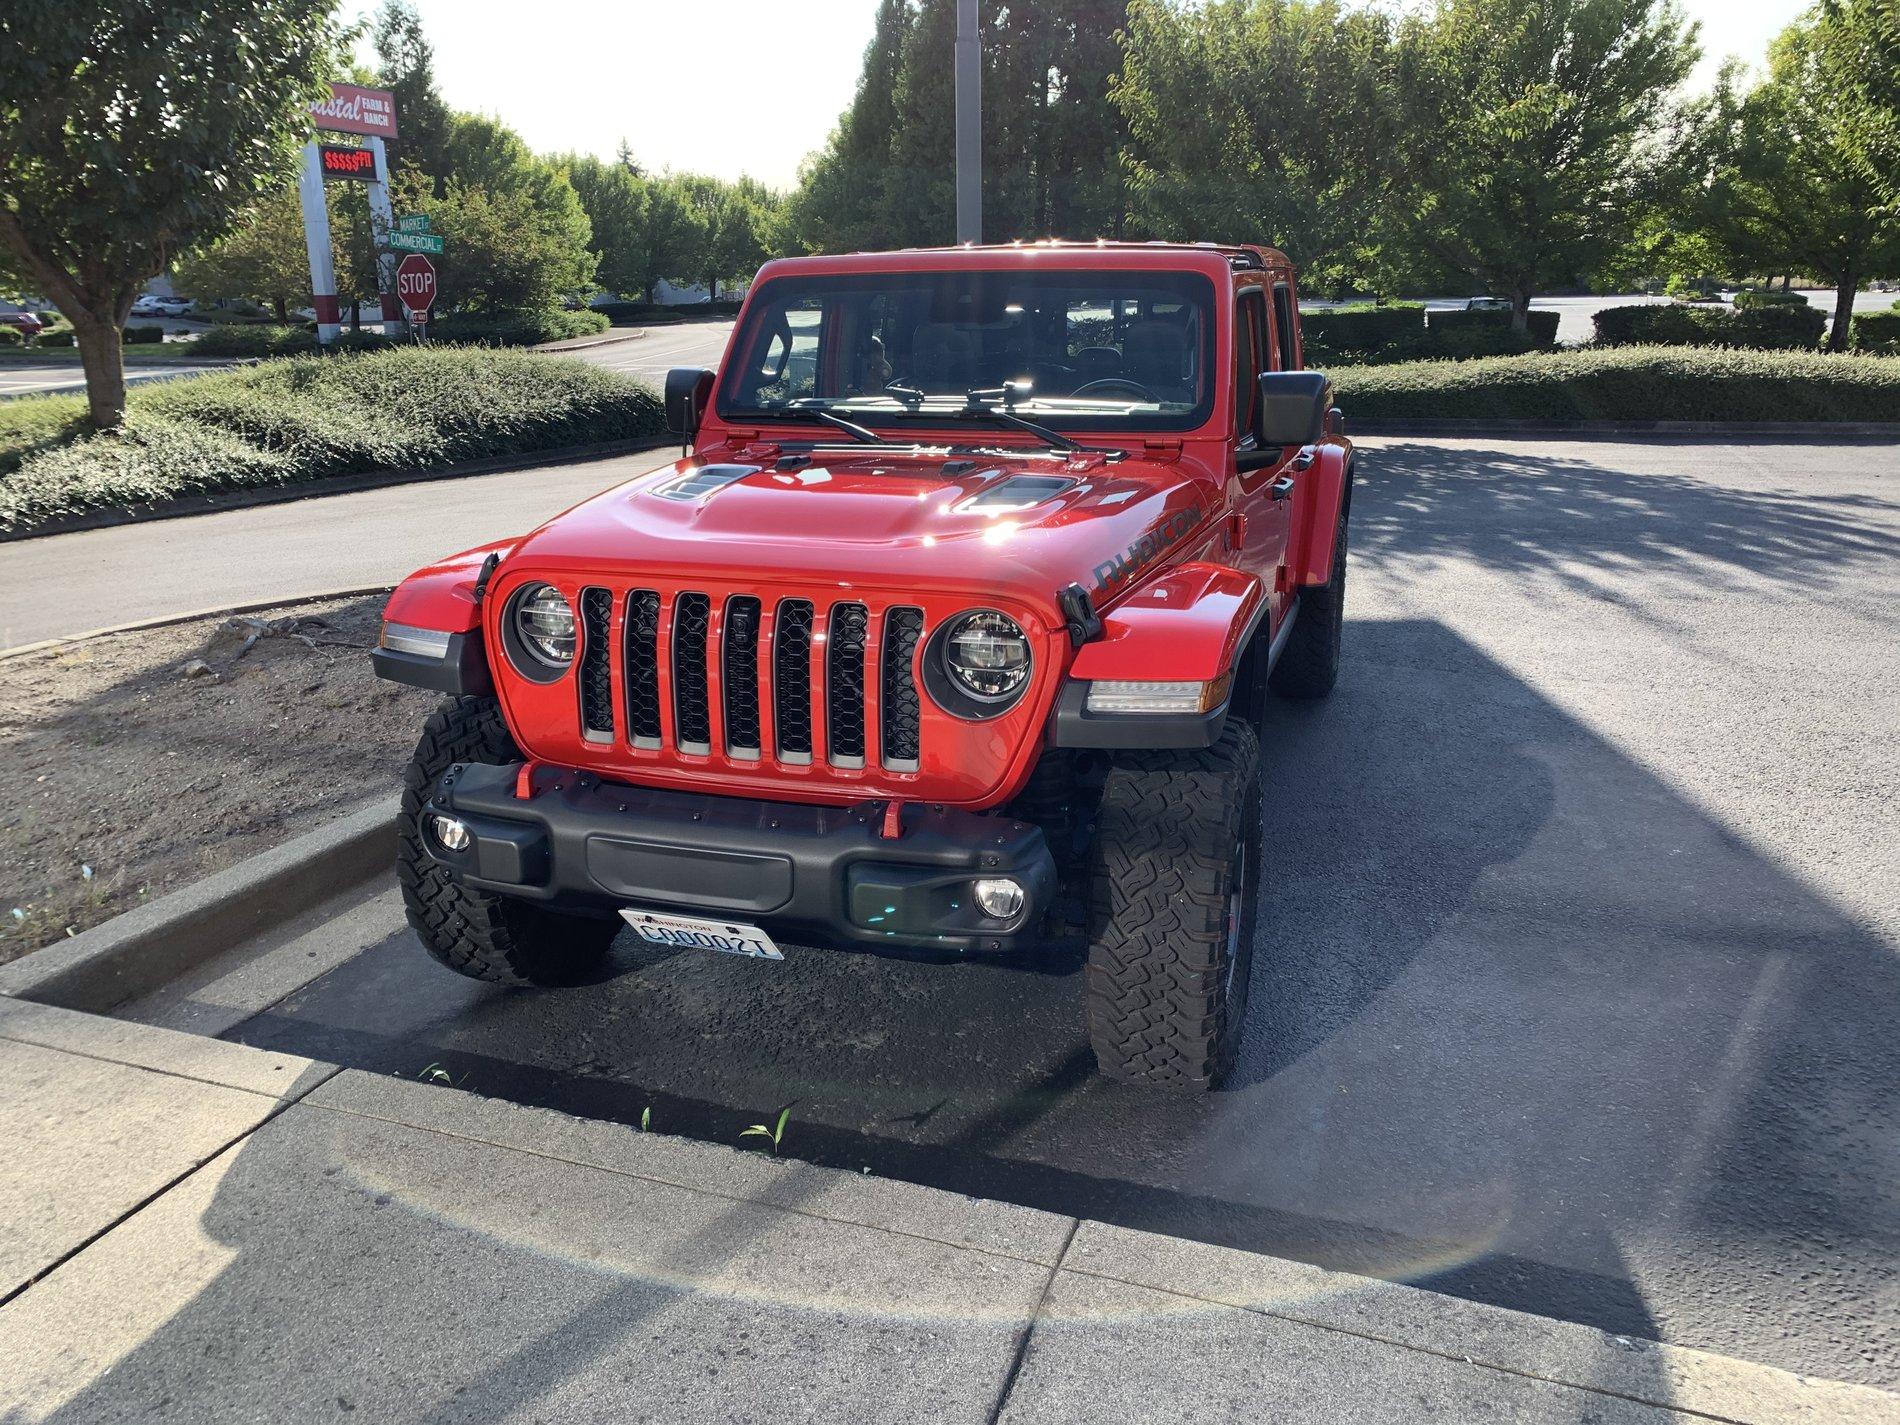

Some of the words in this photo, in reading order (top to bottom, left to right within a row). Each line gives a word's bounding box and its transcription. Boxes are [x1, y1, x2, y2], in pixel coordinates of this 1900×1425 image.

[305, 95, 361, 120] oastal
[361, 97, 383, 112] FARM
[384, 101, 390, 113] &
[363, 112, 389, 126] RANCH
[399, 217, 424, 232] MARKET
[390, 232, 436, 250] COMMERCIAL
[400, 272, 432, 294] STOP
[1093, 504, 1203, 591] RUBICON
[640, 925, 767, 955] C00002T
